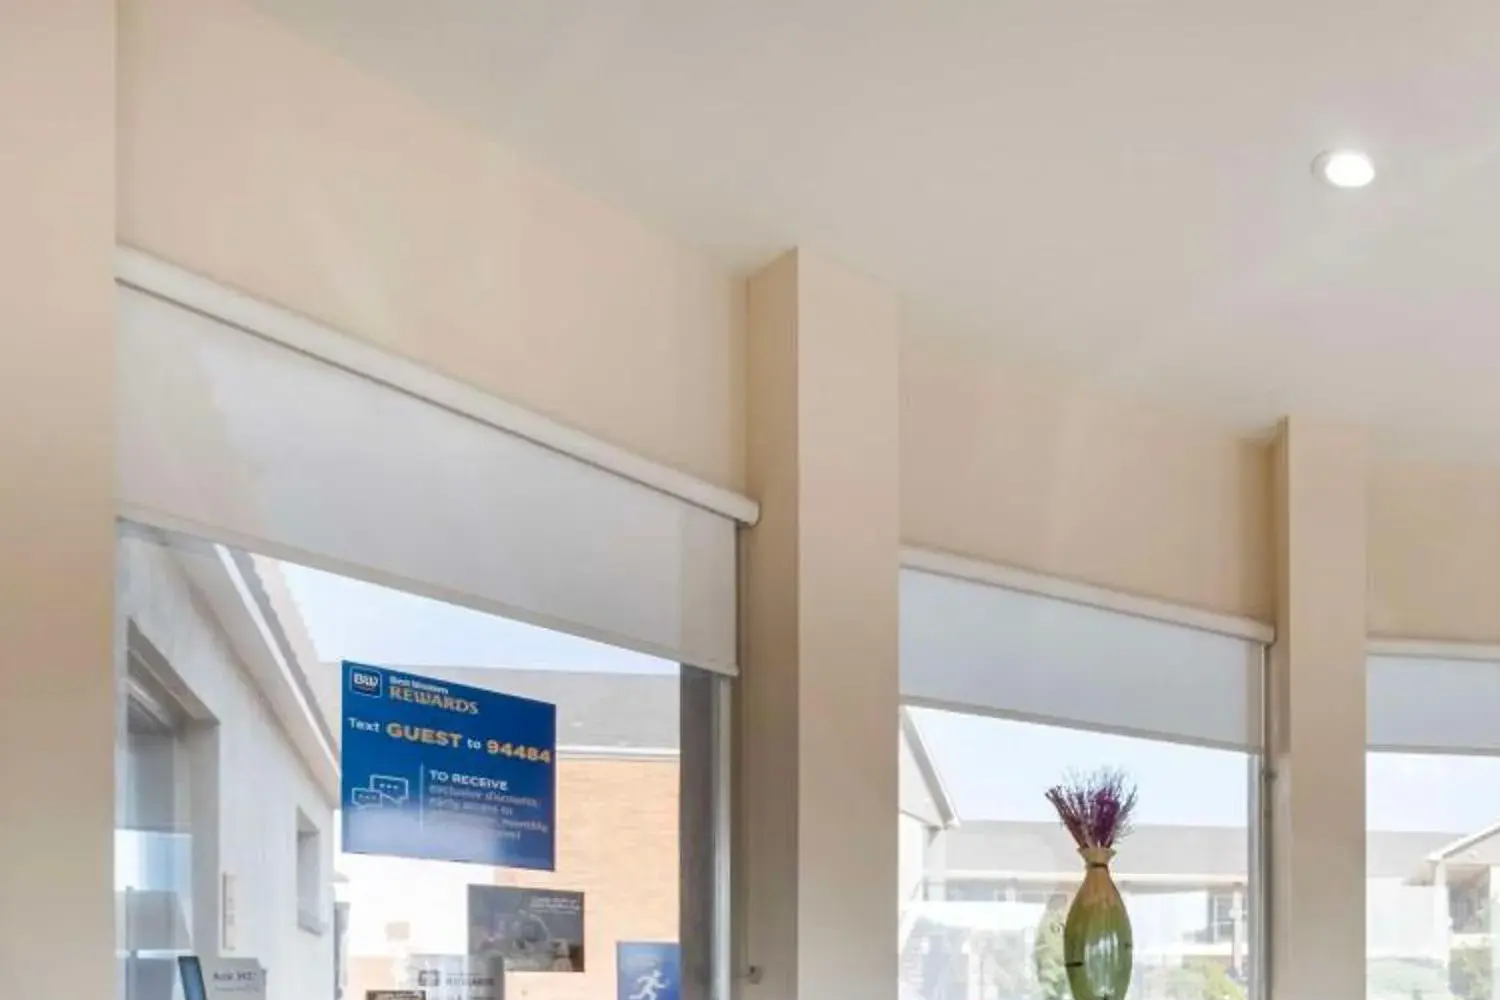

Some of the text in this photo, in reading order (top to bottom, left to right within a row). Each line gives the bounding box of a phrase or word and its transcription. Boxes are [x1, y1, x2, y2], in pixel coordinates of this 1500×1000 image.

[388, 685, 480, 715] REWARDS
[348, 716, 551, 764] Text GUEST to 94484
[429, 769, 509, 791] TO RECEIVE
